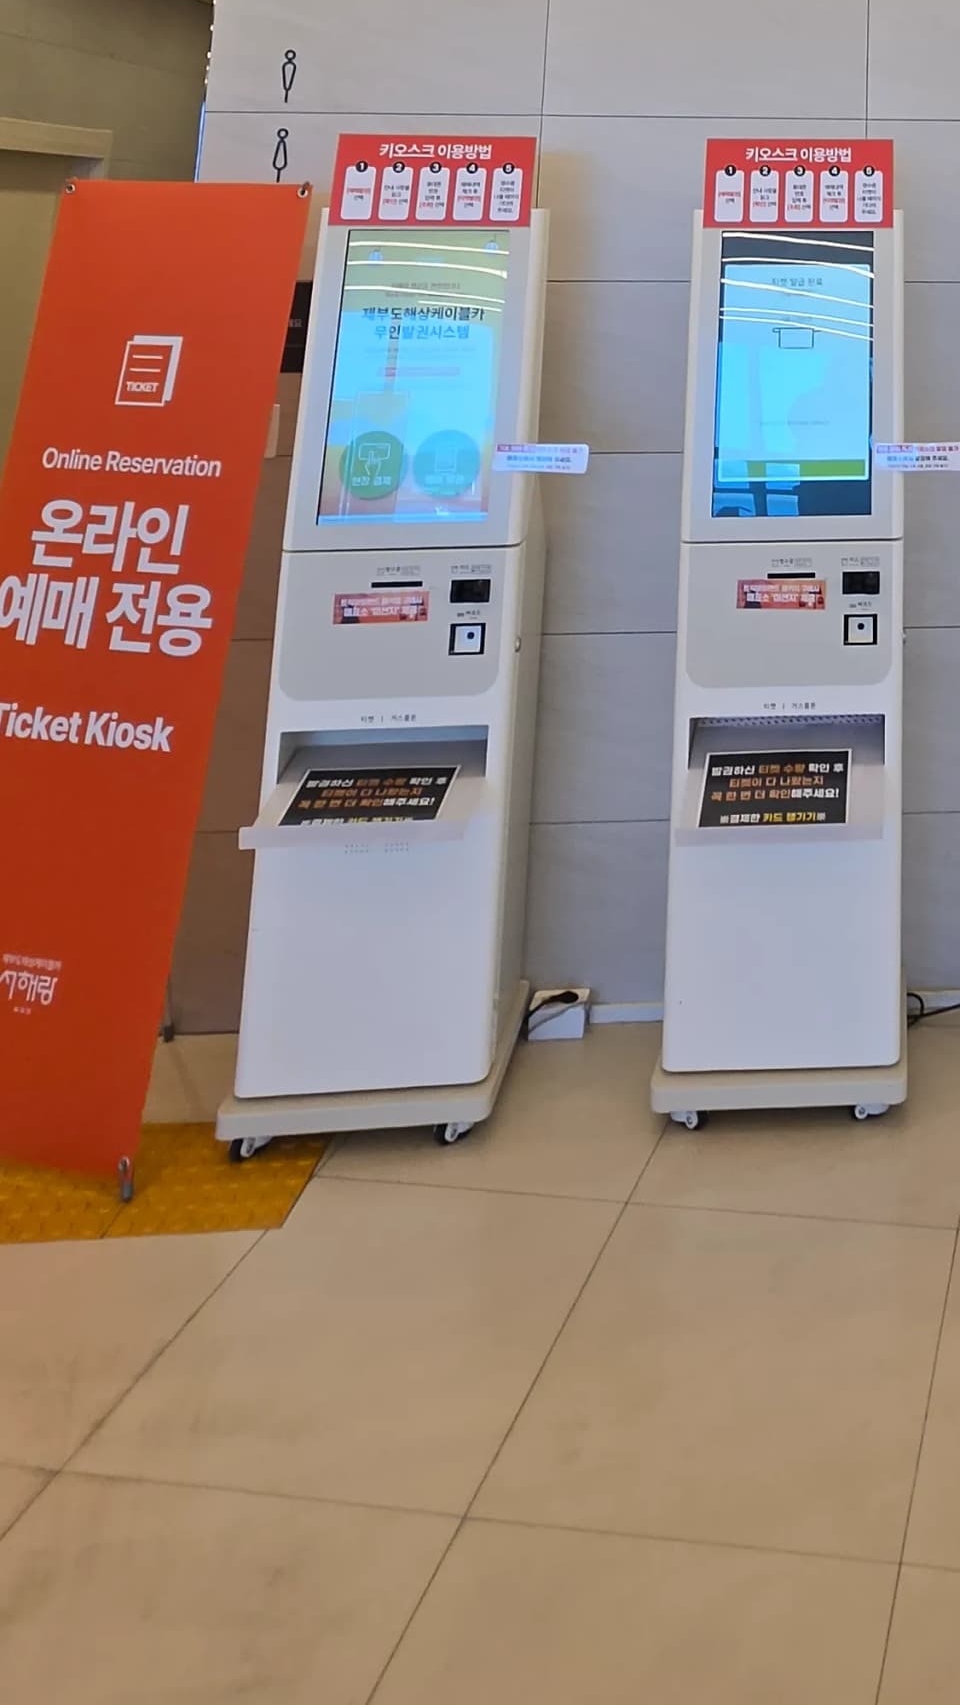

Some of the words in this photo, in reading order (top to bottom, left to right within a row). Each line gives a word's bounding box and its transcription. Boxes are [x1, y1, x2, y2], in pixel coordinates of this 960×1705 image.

[379, 143, 435, 158] 키오스크
[438, 144, 492, 160] 이용방법
[745, 147, 798, 161] 키오스크
[800, 147, 852, 162] 이용방법
[362, 307, 485, 322] 제부도해상케이블카
[374, 325, 470, 340] 무인발권시스템
[126, 381, 160, 393] TICKET
[42, 446, 102, 472] Online
[105, 450, 222, 478] Reservation
[31, 499, 190, 575] 온라인
[0, 573, 100, 650] 예매
[105, 581, 213, 658] 전용
[84, 710, 174, 753] Kiosk
[758, 764, 781, 774] 티켓
[808, 763, 830, 773] 확인
[833, 763, 844, 772] 후
[765, 776, 777, 786] 다
[754, 789, 765, 799] 더
[762, 812, 783, 822] 카드
